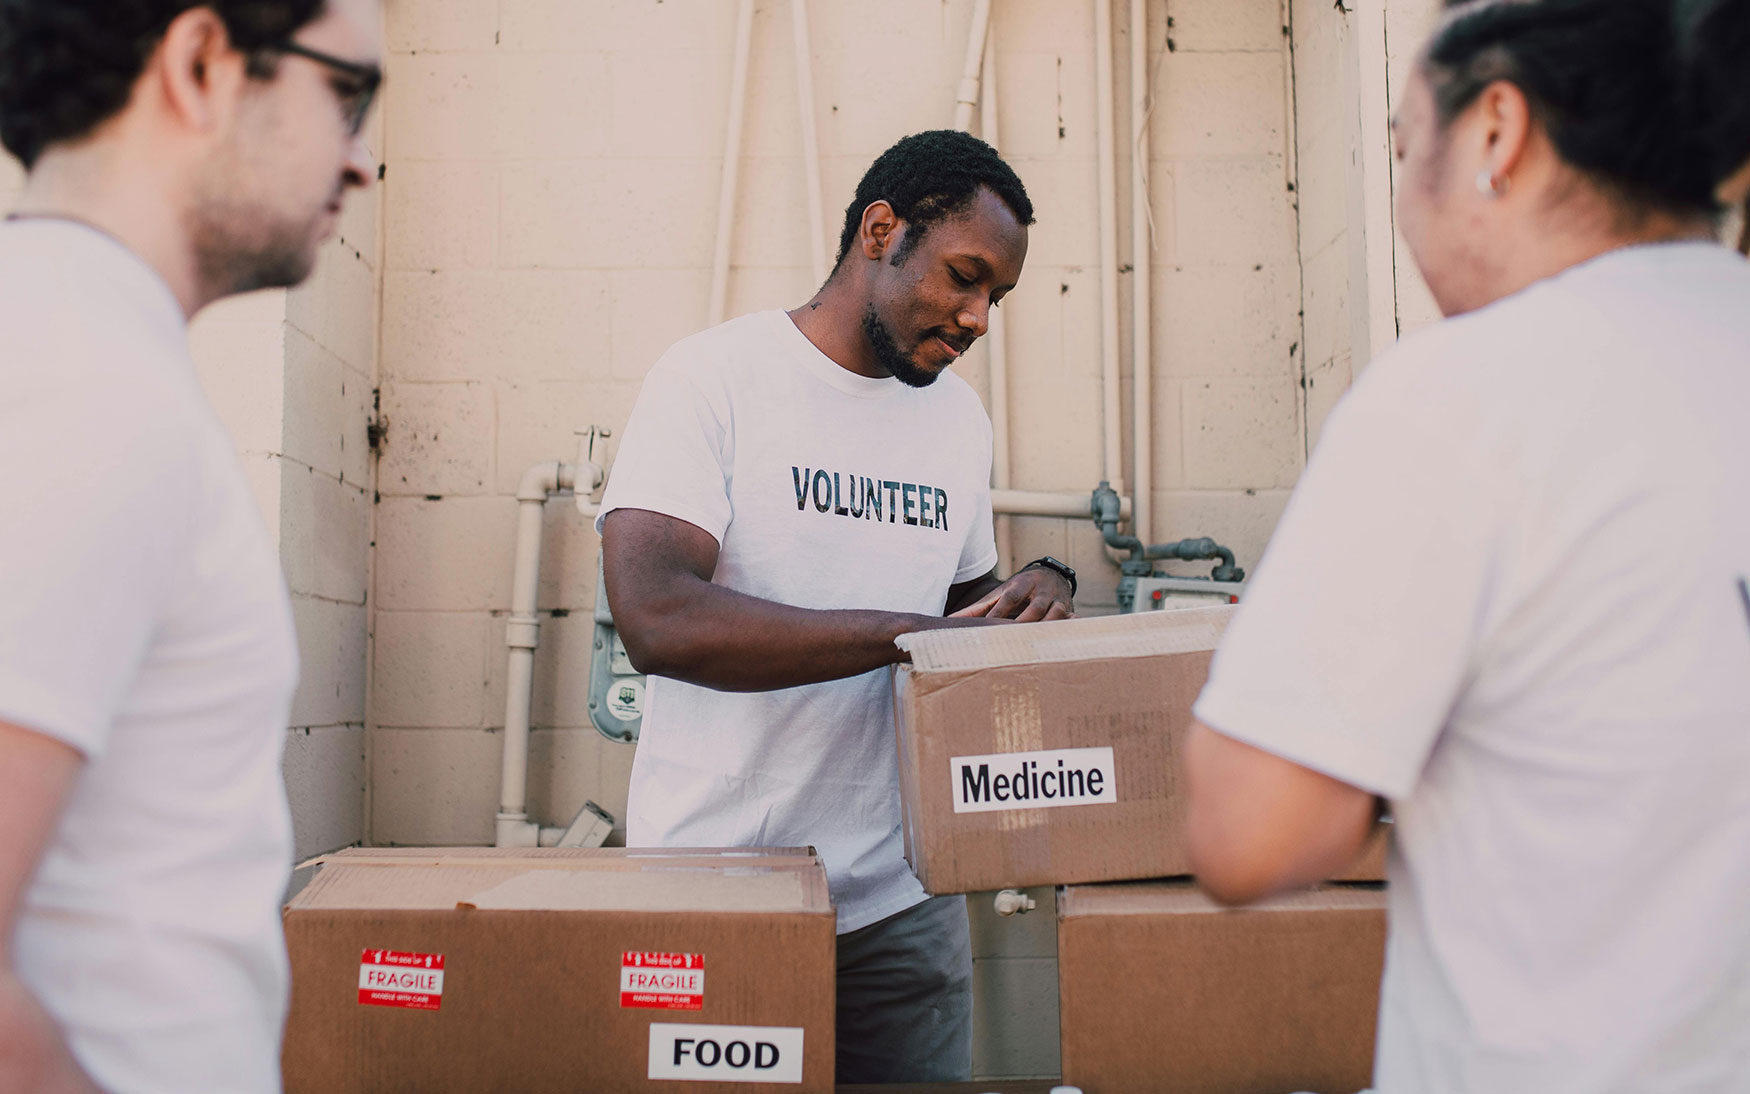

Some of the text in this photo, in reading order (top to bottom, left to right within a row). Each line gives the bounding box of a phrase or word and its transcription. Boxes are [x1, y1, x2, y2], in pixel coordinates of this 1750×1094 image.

[791, 466, 948, 531] VOLUNTEER
[961, 760, 1104, 803] Medicine
[368, 970, 437, 990] FRAGILE
[629, 973, 697, 990] FRAGILE
[673, 1038, 780, 1069] FOOD
